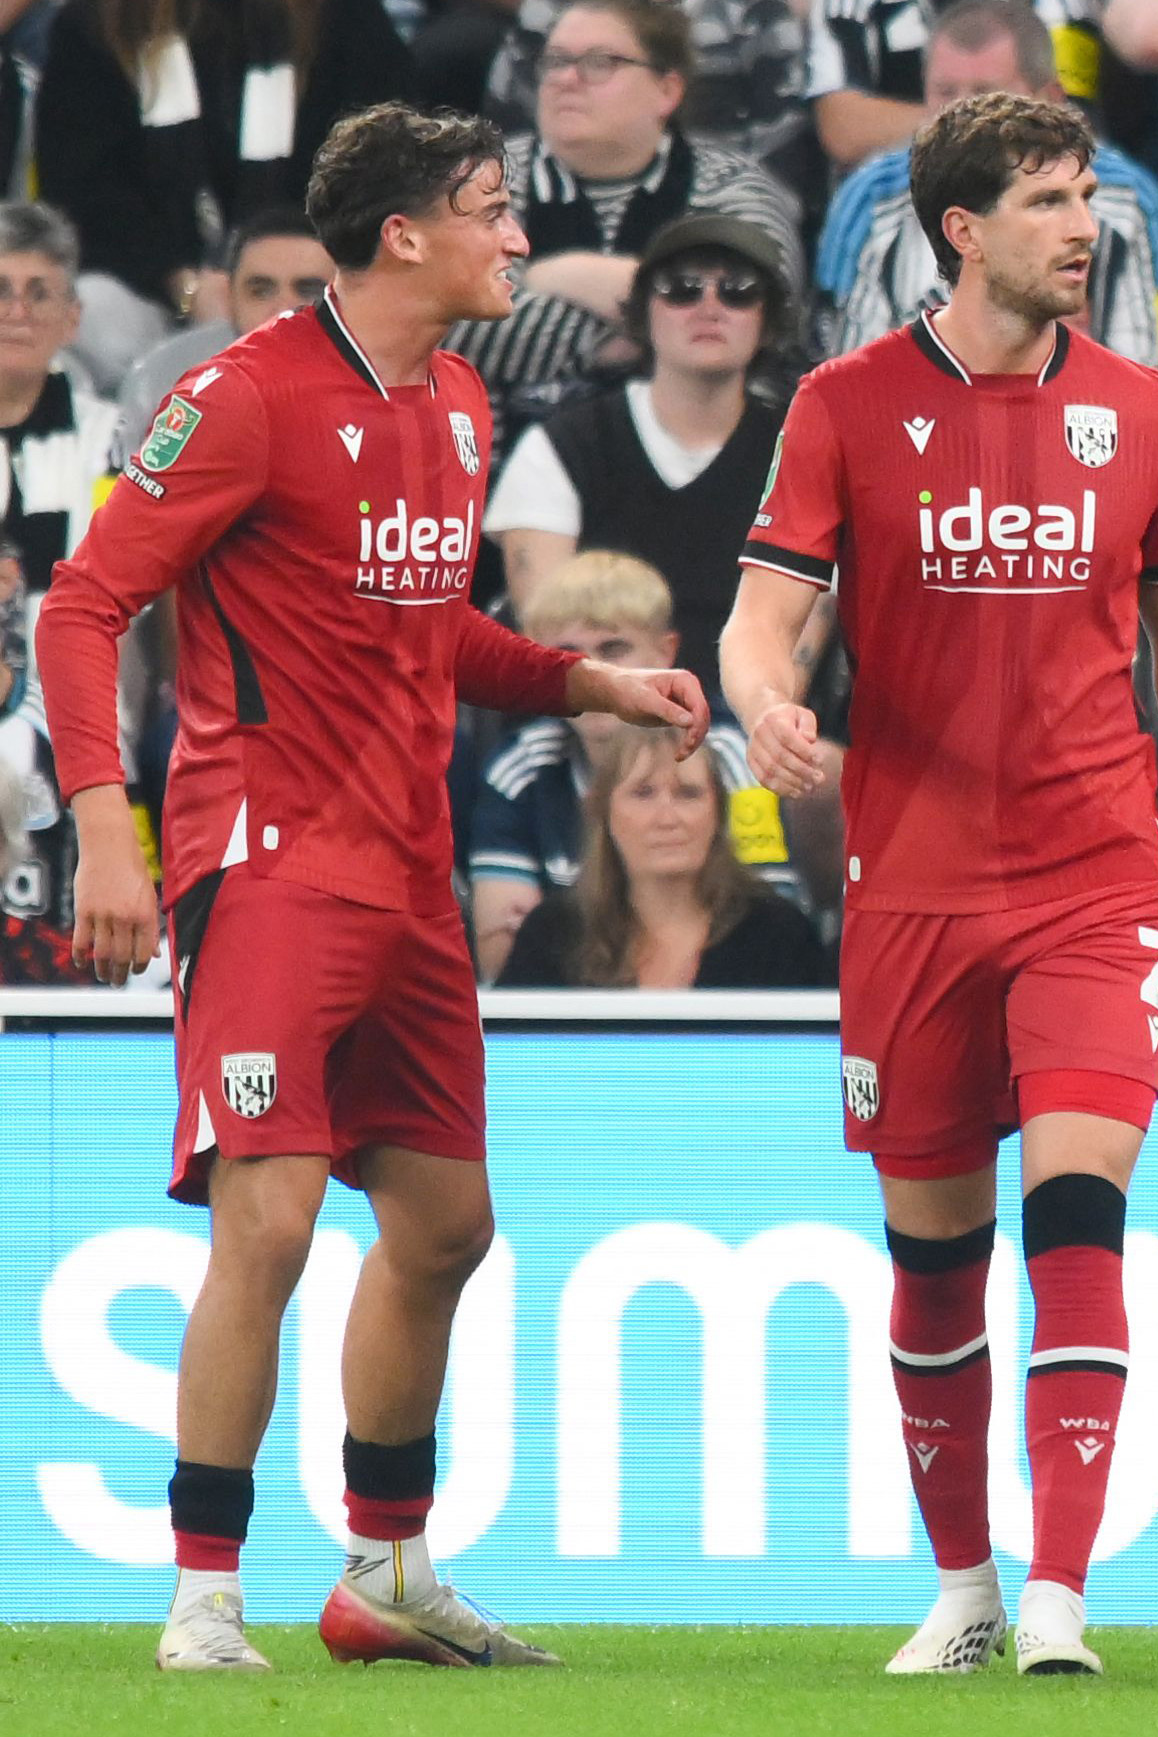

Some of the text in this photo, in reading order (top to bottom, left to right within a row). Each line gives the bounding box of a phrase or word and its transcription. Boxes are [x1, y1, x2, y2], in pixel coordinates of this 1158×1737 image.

[1069, 414, 1112, 427] ALBION
[358, 499, 475, 563] ideal
[918, 487, 1096, 552] ideal
[355, 567, 468, 590] HEATING
[921, 555, 1091, 580] HEATING
[226, 1062, 271, 1074] ALBION
[1059, 1417, 1110, 1431] WBA
